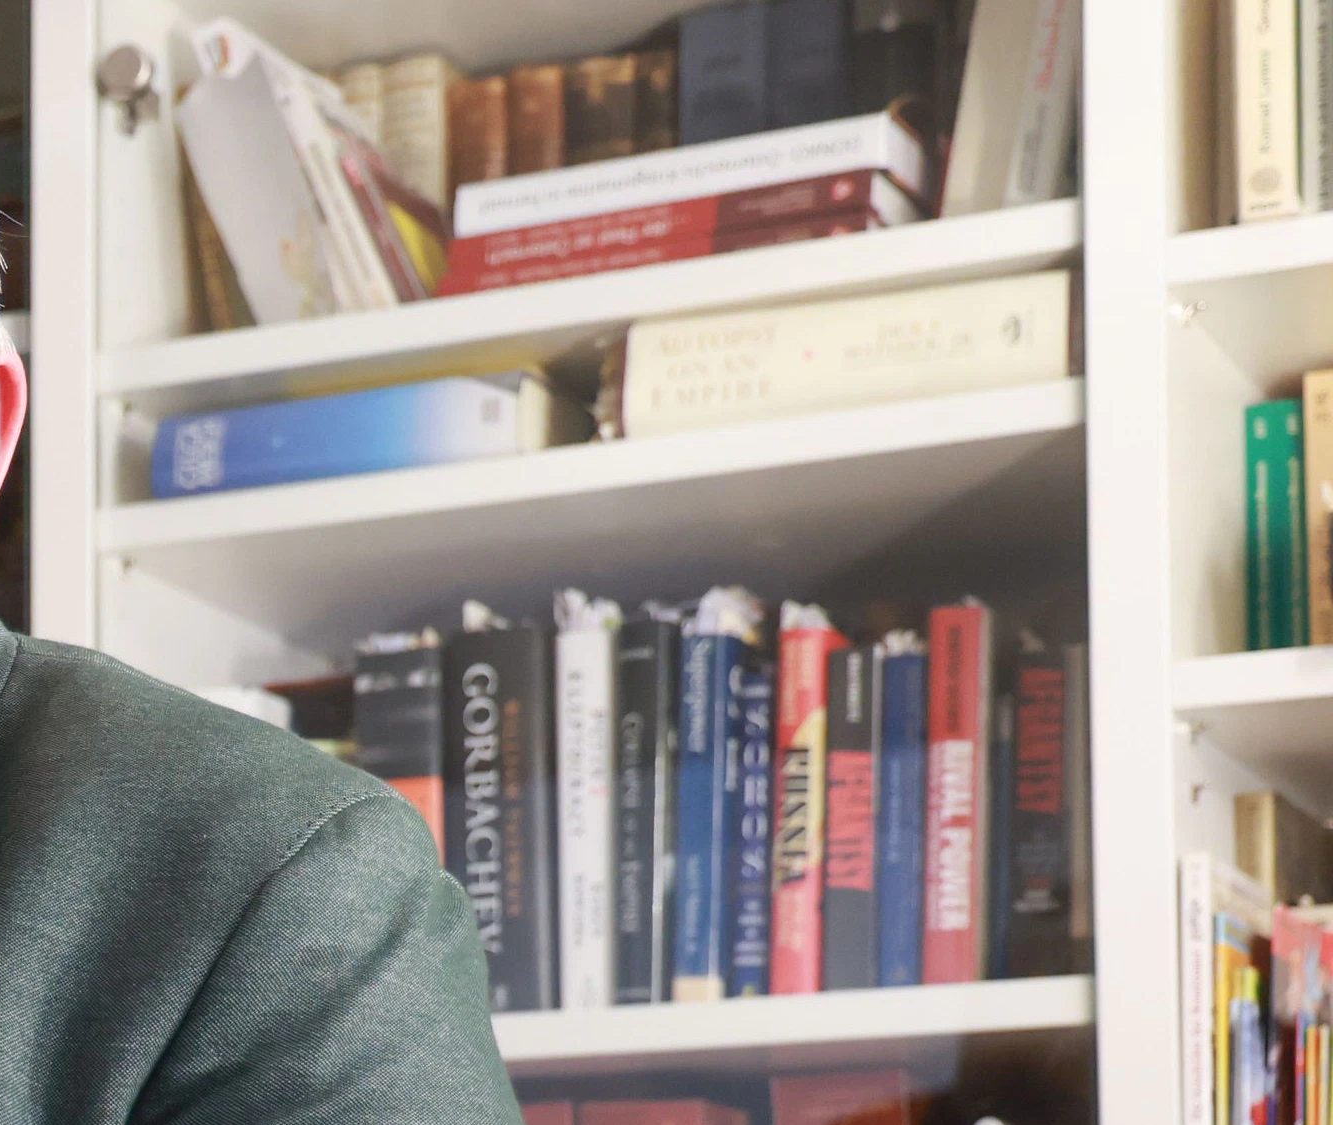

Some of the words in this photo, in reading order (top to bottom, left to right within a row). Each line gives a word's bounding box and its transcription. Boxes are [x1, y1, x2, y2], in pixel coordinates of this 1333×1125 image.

[658, 323, 779, 357] AUTOPSY
[649, 378, 774, 410] EMPIRE
[461, 661, 504, 955] GORBACHEV
[779, 746, 811, 886] RUSSIA
[937, 740, 975, 816] RIVAL
[936, 826, 974, 931] POWER
